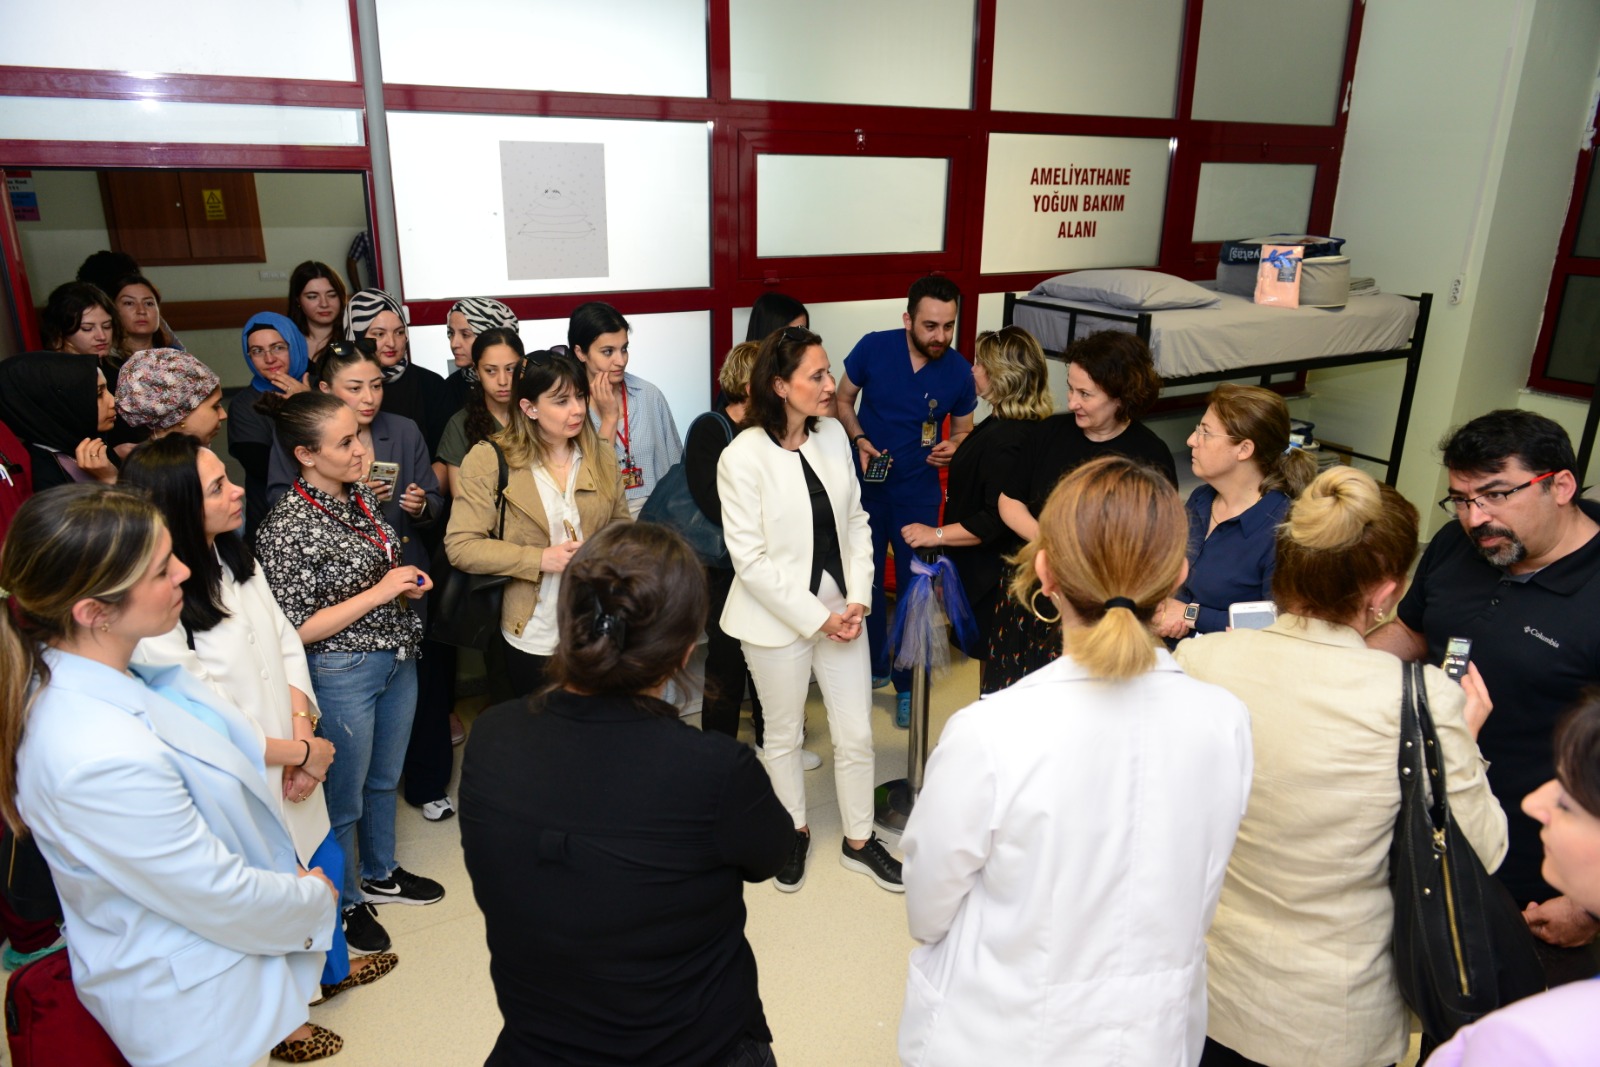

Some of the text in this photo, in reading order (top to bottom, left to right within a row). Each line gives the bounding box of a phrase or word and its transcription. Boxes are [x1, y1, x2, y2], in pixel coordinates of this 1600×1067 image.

[1030, 163, 1131, 186] AMELİYATHANE
[1033, 190, 1125, 212] YOĞUN BAKIM
[1057, 221, 1097, 238] ALANI
[1530, 628, 1560, 648] Columbia
